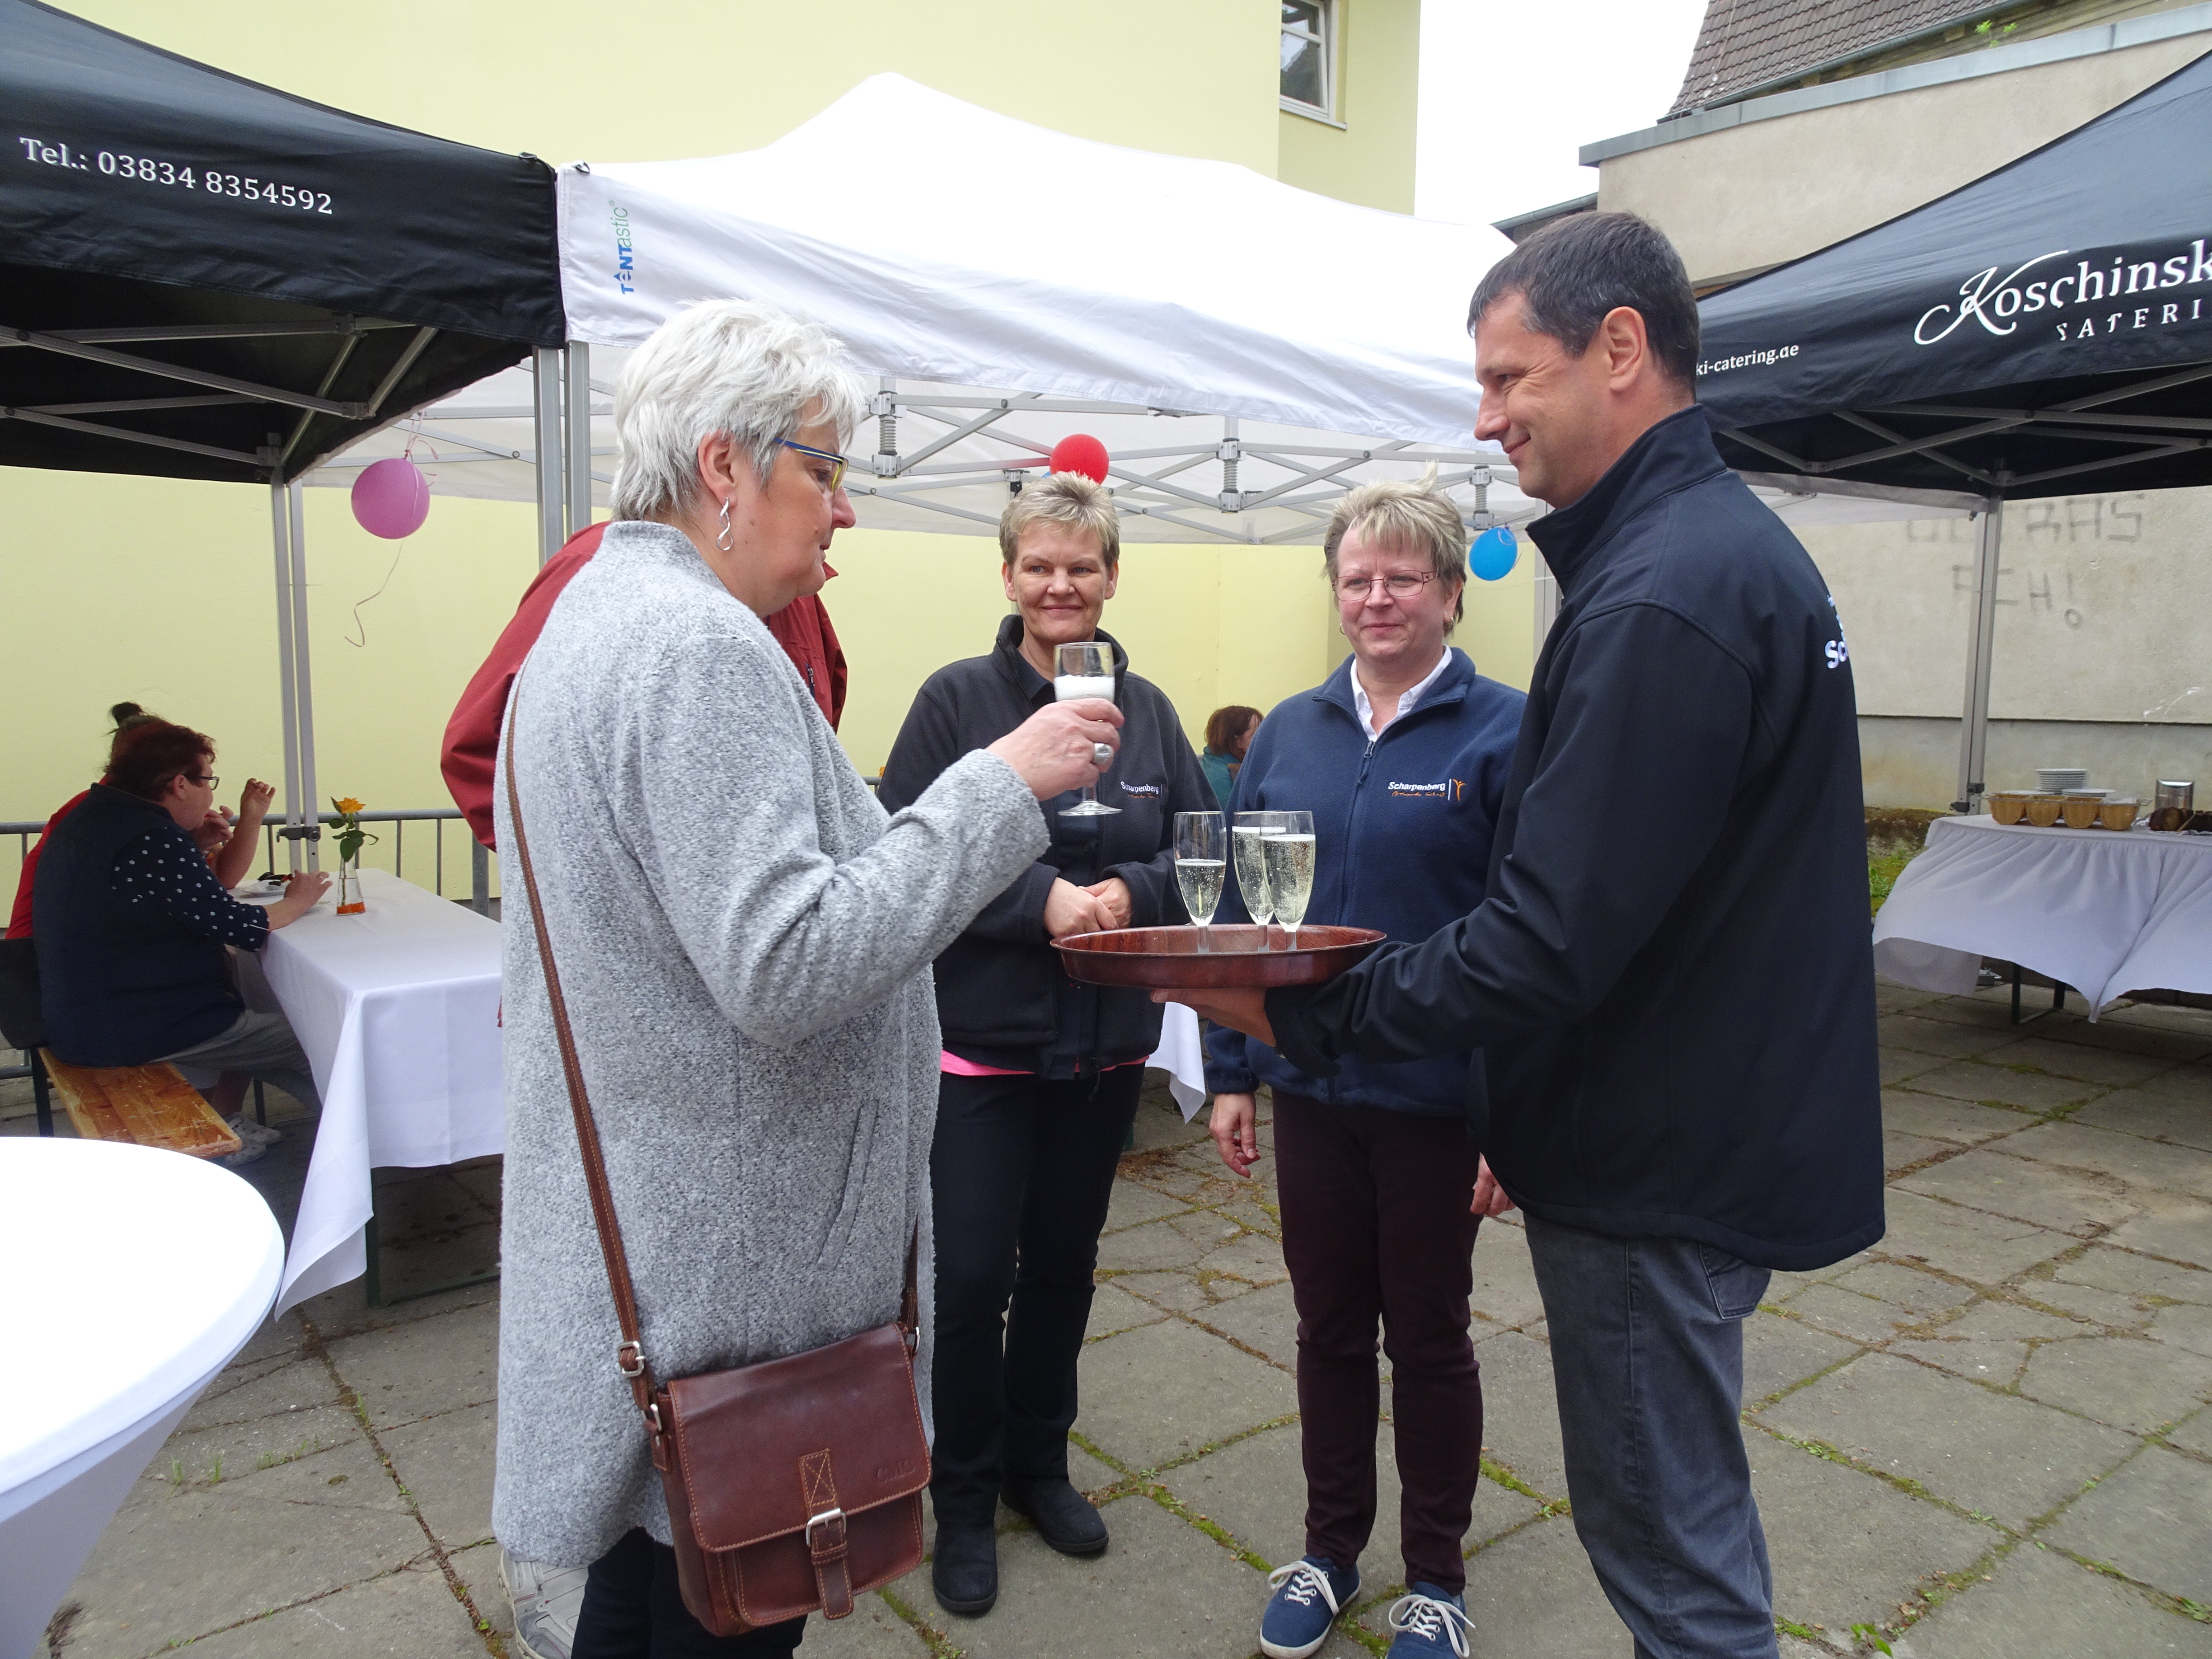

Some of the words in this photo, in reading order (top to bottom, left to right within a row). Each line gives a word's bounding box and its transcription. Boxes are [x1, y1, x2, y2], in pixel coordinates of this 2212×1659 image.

[19, 136, 89, 171] Tel.:
[98, 151, 196, 188] 03834
[205, 171, 333, 214] 8354592
[1120, 781, 1159, 794] Scharpenberg
[1388, 781, 1445, 791] Scharpenberg
